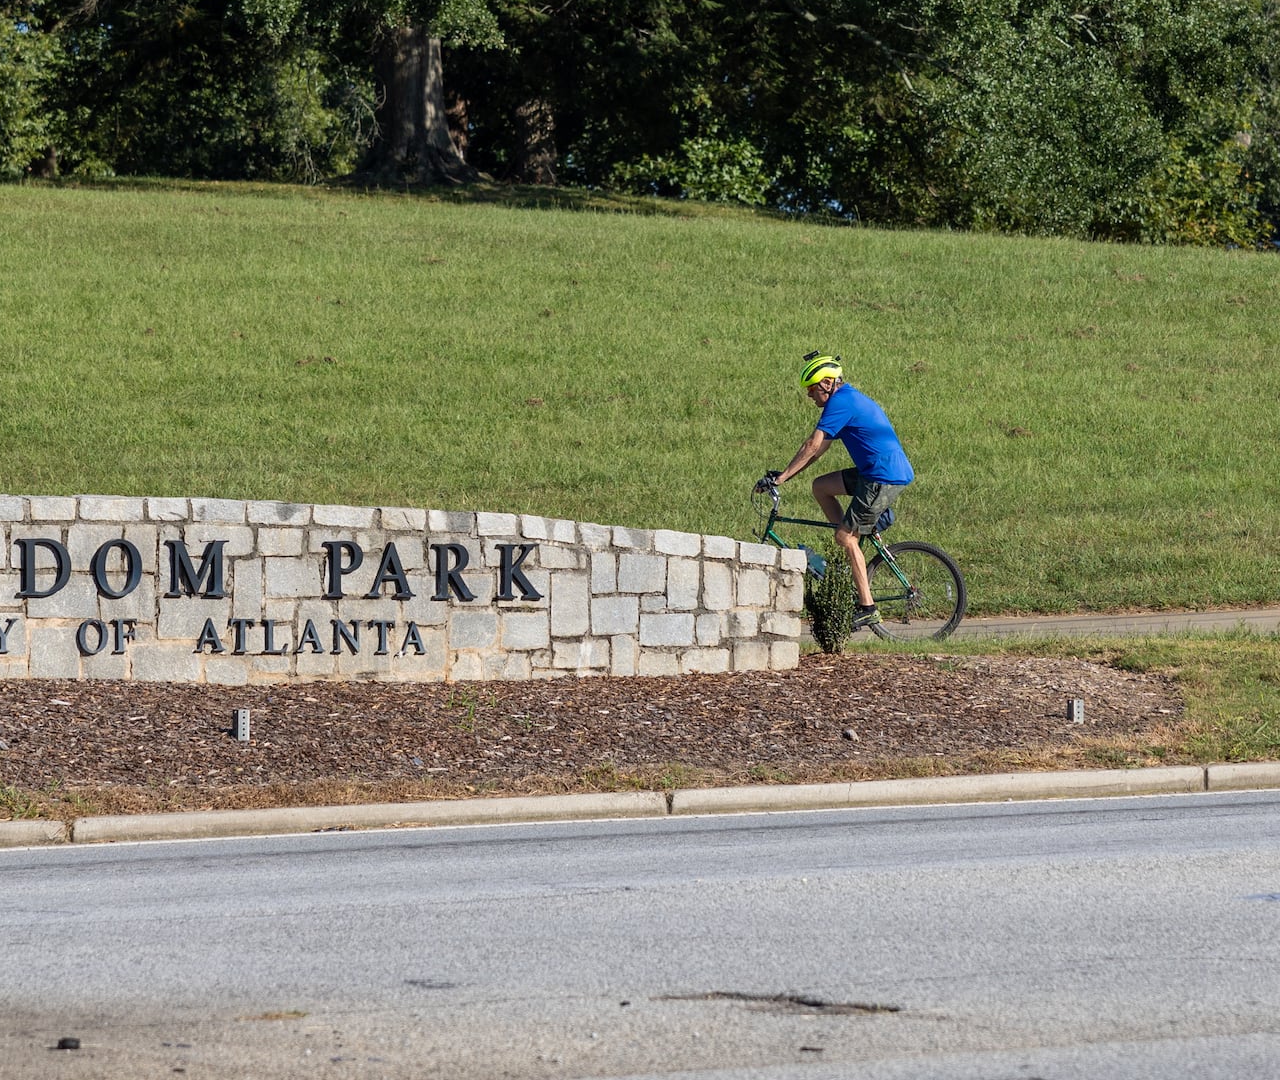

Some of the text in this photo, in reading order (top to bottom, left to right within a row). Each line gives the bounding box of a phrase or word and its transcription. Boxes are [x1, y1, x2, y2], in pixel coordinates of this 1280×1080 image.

[321, 540, 545, 603] PARK
[75, 619, 137, 656] OF
[193, 618, 426, 656] ATLANTA
